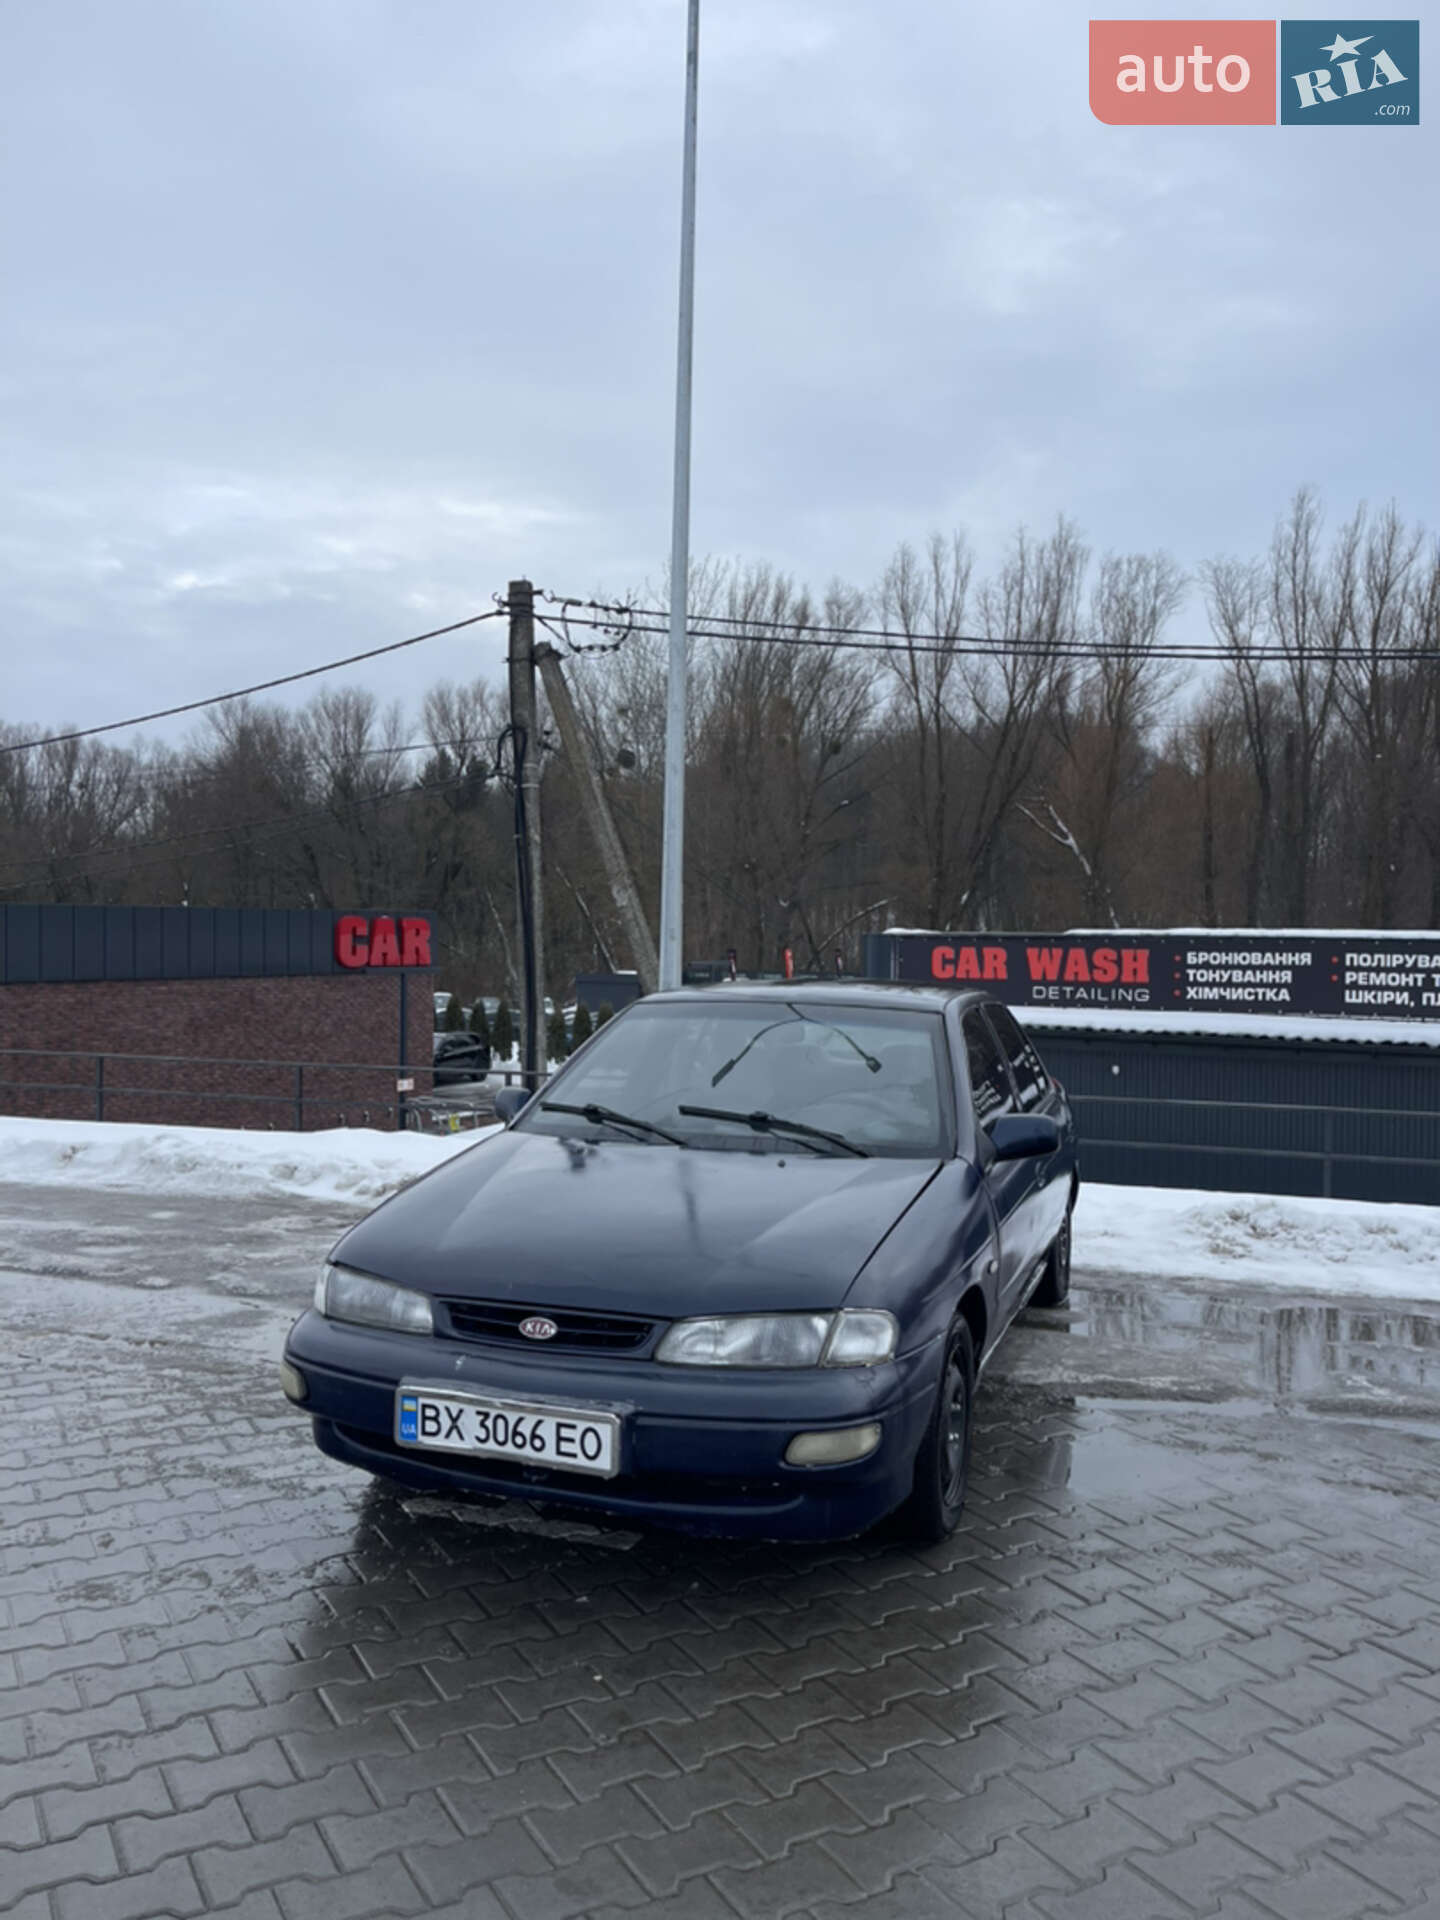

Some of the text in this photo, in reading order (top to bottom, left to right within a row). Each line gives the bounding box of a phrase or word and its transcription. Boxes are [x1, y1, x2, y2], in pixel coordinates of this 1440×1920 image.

[335, 915, 431, 969] CAR
[931, 946, 1150, 983] CAR WASH
[1186, 952, 1312, 966] БРОНЮВАННЯ
[1186, 969, 1292, 984] ТОНУВАННЯ
[1345, 971, 1426, 987] РЕМОНТ
[1032, 985, 1150, 1002] DETAILING
[1186, 986, 1291, 1002] ХІМЧИСТКА
[1345, 990, 1415, 1008] ШКІРИ,
[420, 1403, 602, 1461] BX 3066 EO
